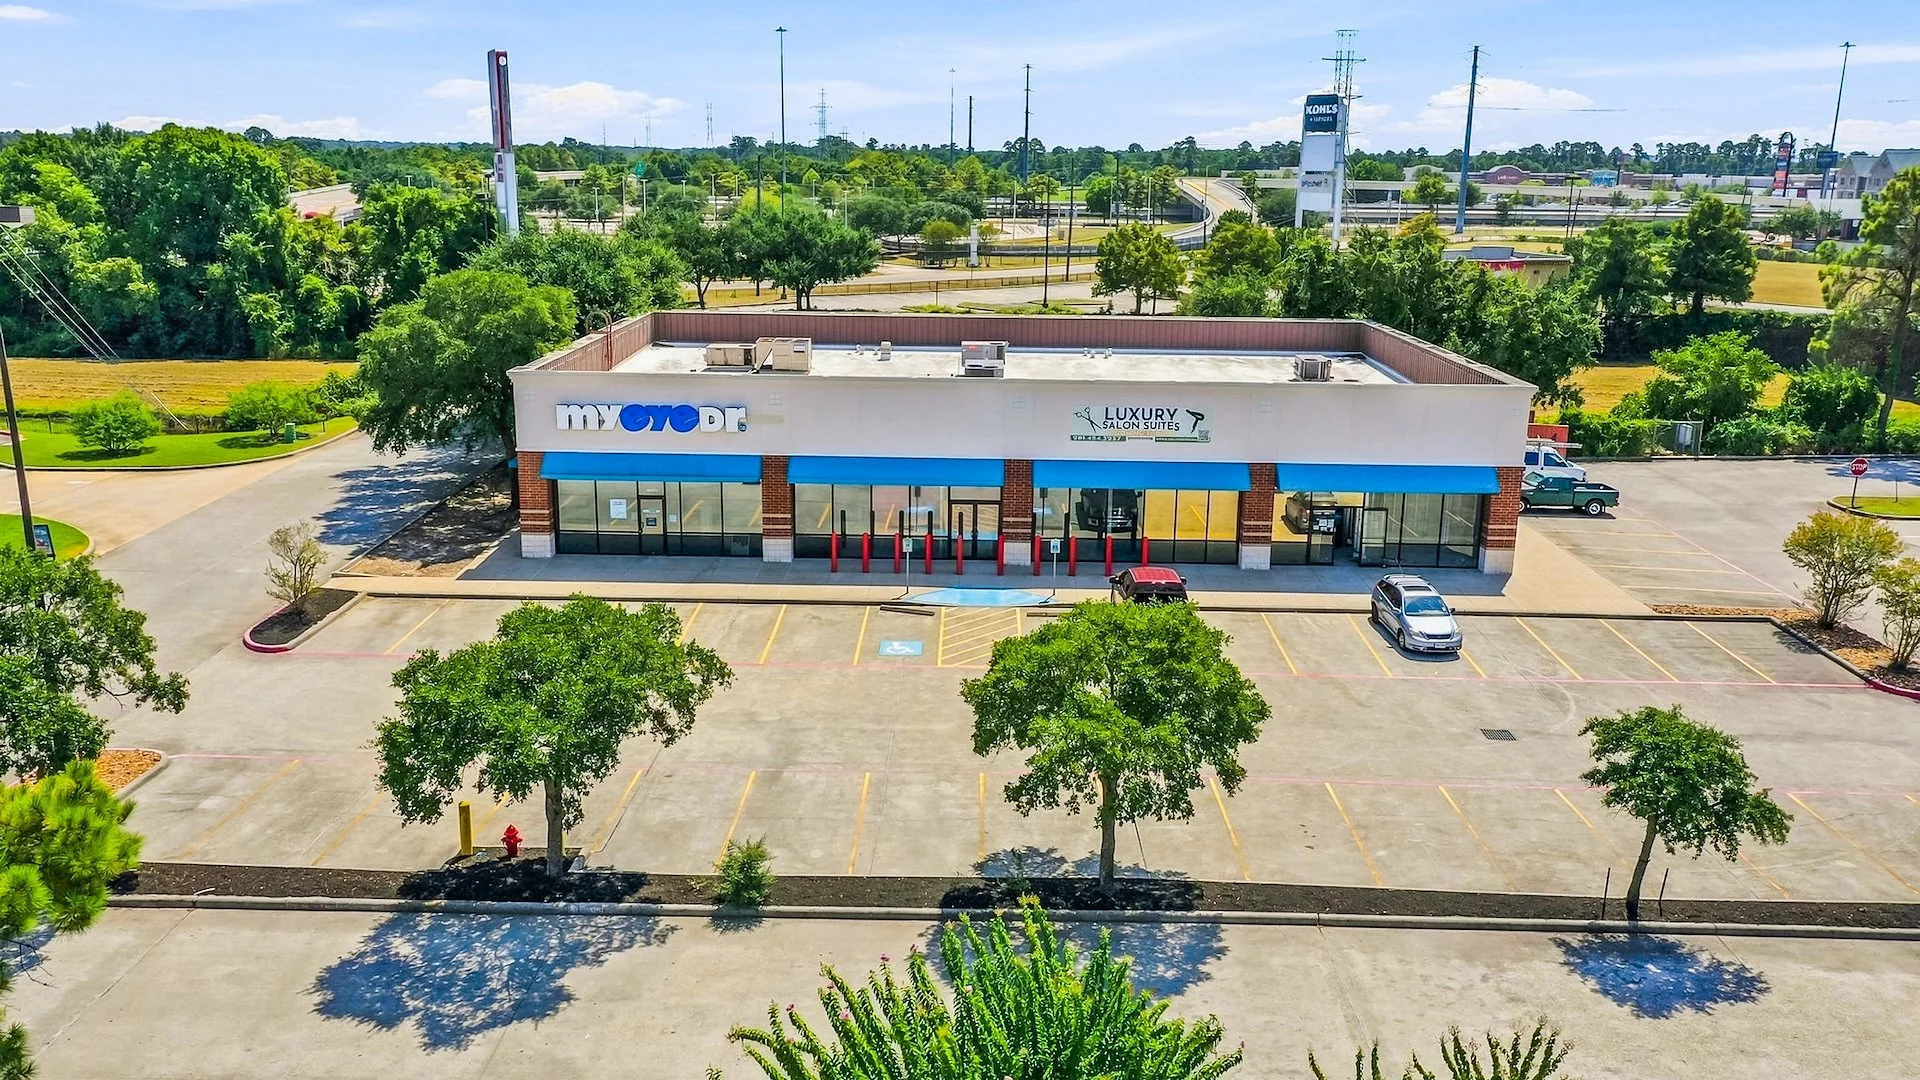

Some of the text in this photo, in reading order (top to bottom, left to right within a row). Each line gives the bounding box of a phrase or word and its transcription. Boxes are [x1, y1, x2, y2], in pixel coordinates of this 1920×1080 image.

[1305, 104, 1338, 115] KOHL'S
[1104, 407, 1179, 421] LUXURY
[1102, 420, 1180, 432] SALON SUITES
[1852, 463, 1868, 471] STOP
